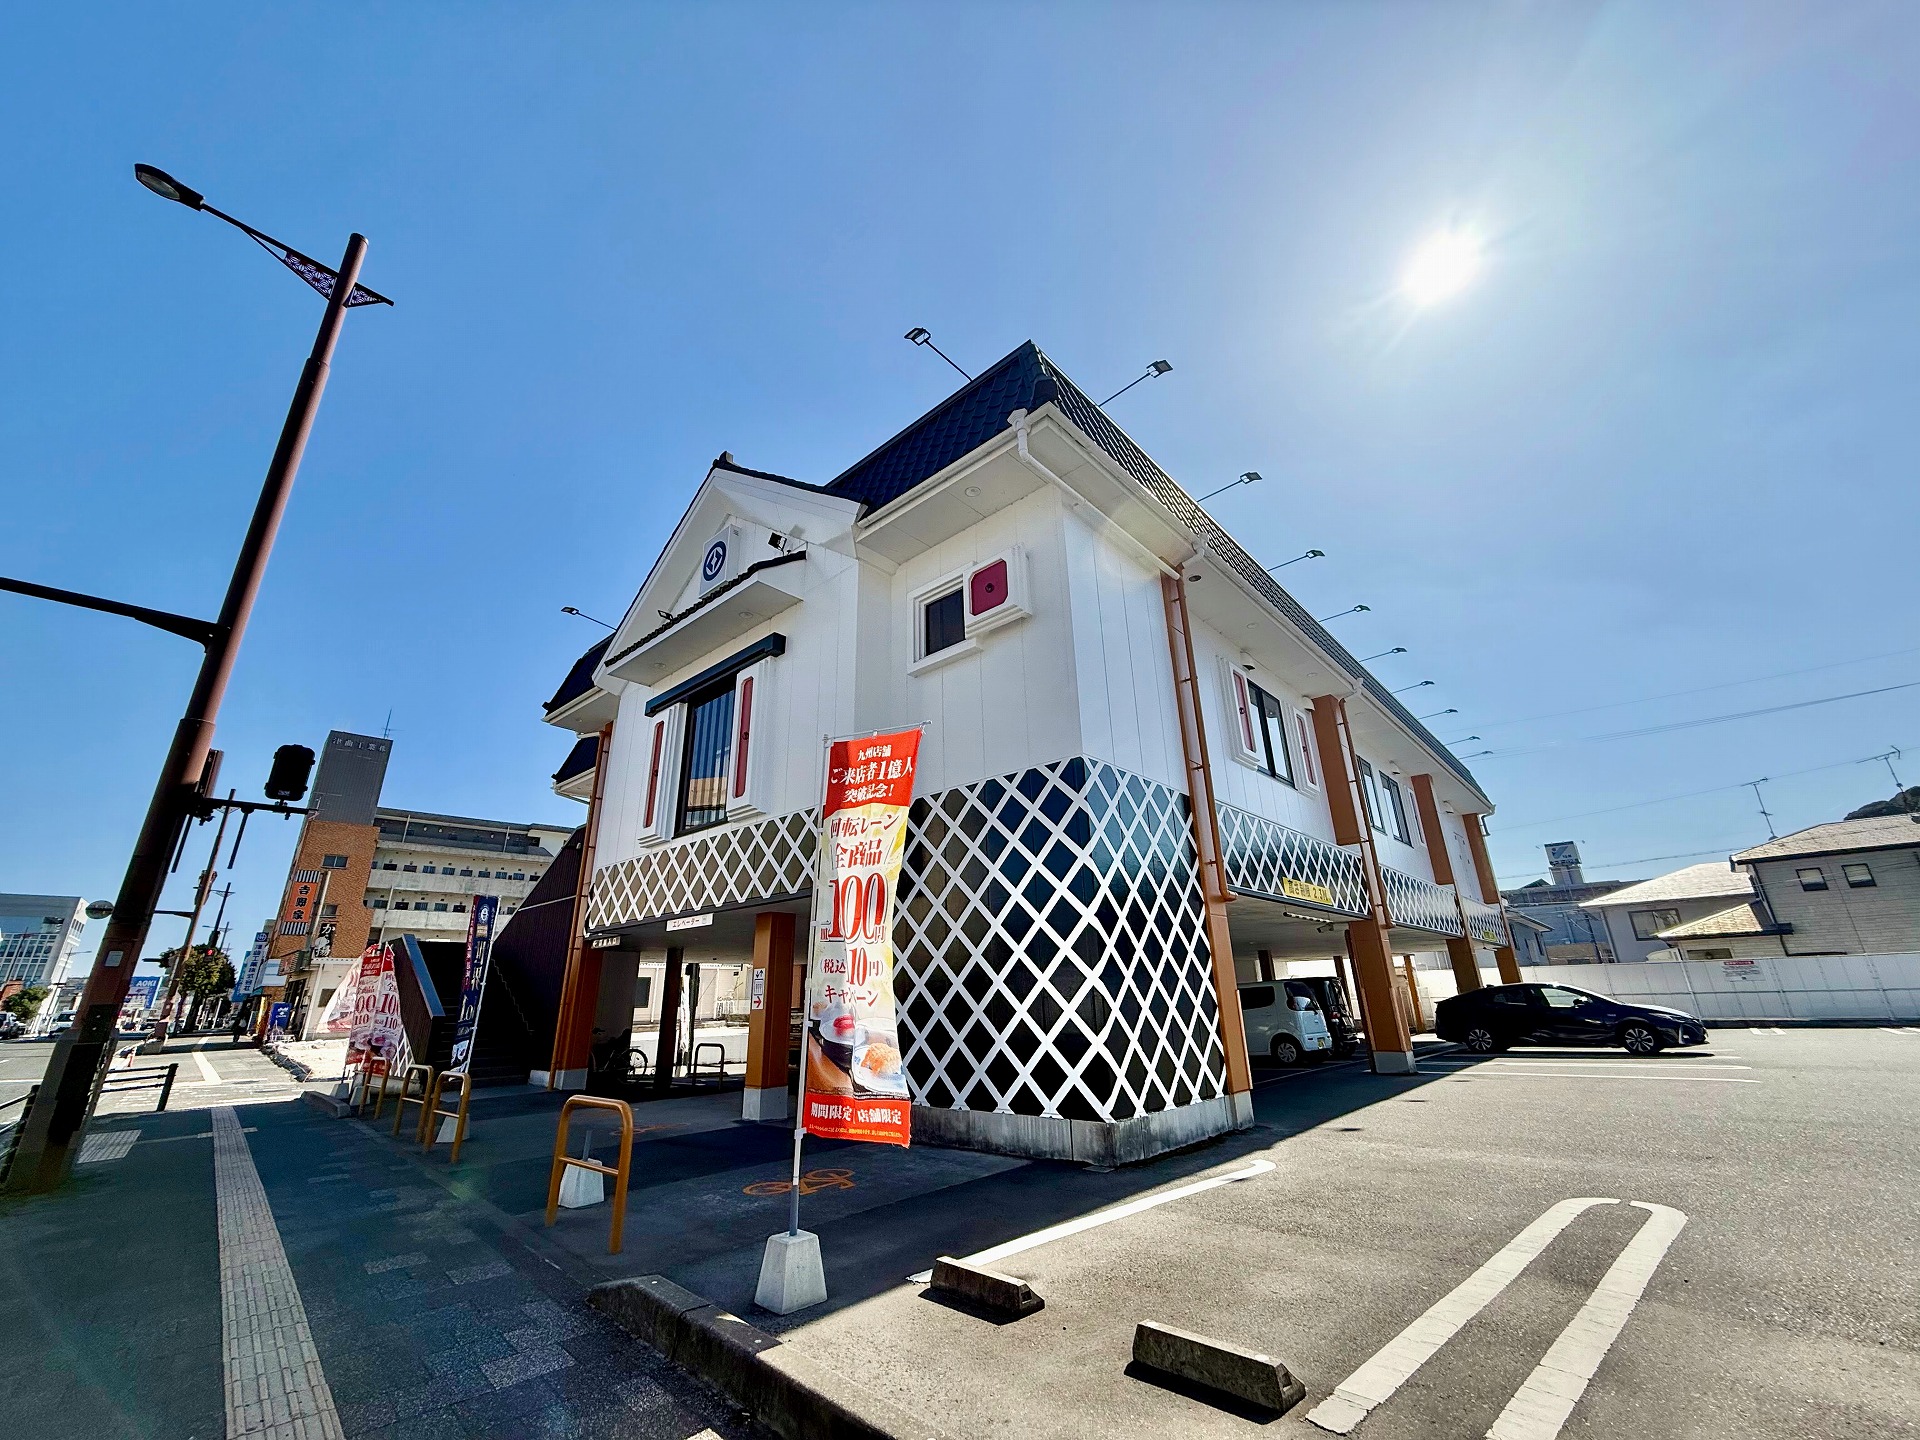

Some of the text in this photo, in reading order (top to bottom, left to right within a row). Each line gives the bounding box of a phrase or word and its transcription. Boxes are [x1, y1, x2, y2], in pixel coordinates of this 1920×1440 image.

[858, 745, 892, 761] 九州店舗
[831, 757, 913, 785] ご来店者1億人
[830, 815, 899, 839] 回転レーン
[835, 838, 882, 868] 全商品
[811, 1102, 902, 1125] 期間限定 店舗限定
